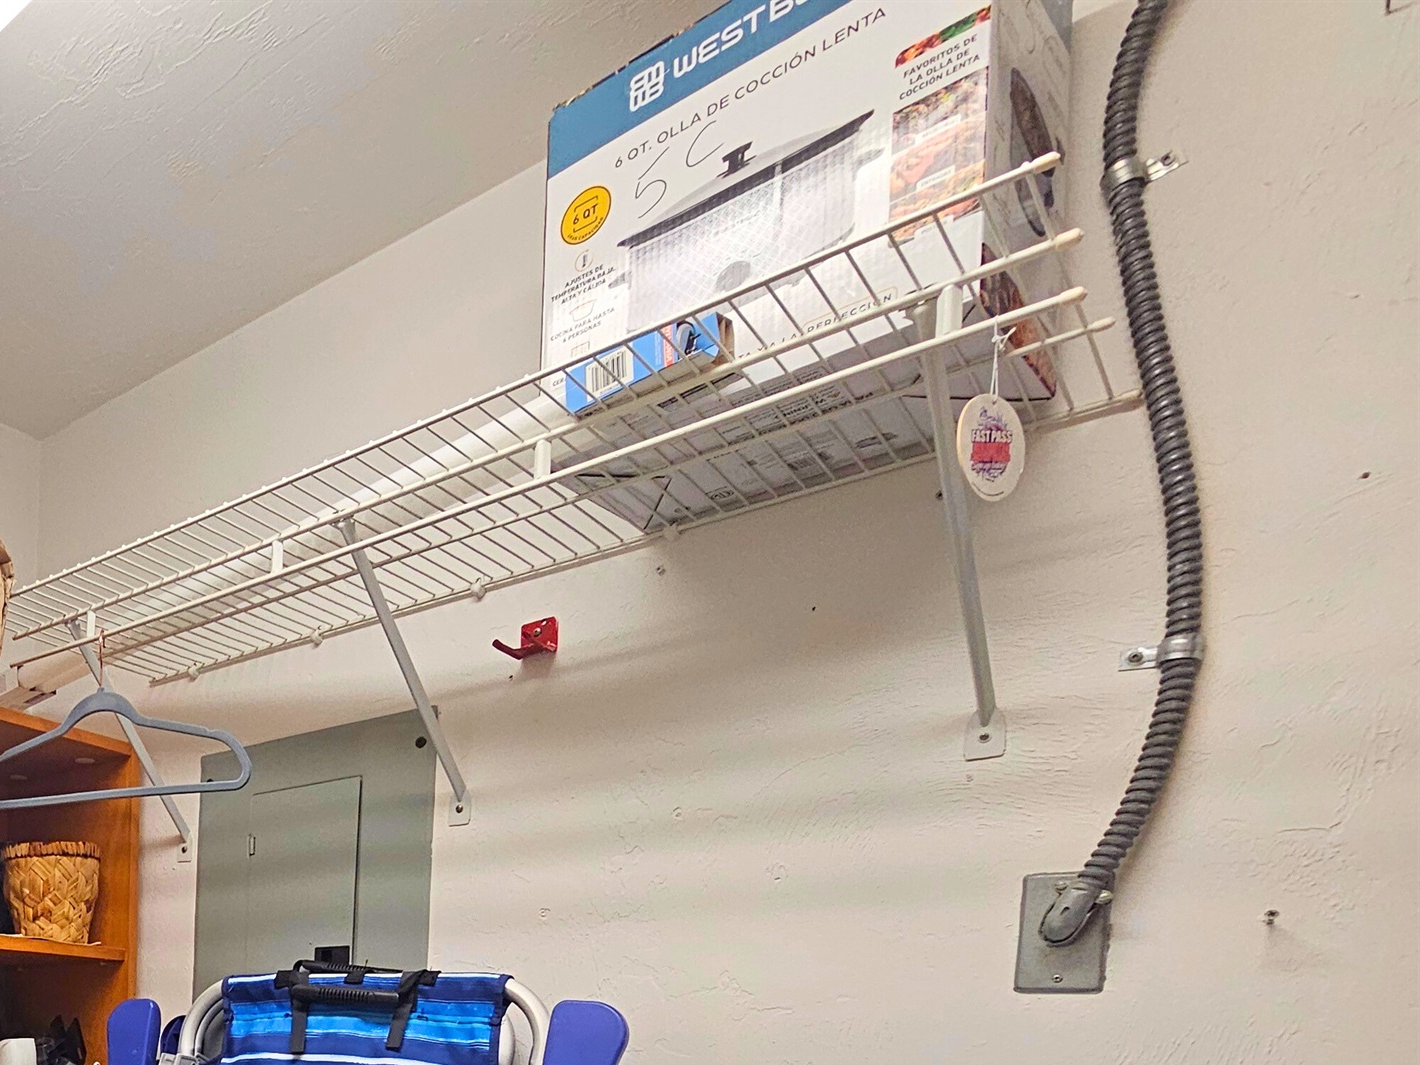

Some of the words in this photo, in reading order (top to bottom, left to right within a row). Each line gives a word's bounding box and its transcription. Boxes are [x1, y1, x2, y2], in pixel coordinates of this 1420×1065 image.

[673, 5, 767, 78] WEST
[902, 43, 961, 80] FAVORITOS
[963, 33, 978, 48] DE
[614, 156, 624, 168] 6
[656, 112, 702, 144] OLLA
[706, 95, 730, 117] DE
[734, 45, 817, 100] COCCIÓN
[821, 7, 886, 52] LENTA
[899, 73, 943, 101] COCCIÓN
[945, 53, 981, 82] LENTA
[909, 73, 925, 86] LA
[926, 57, 954, 78] OLLA
[955, 48, 971, 62] DE
[572, 213, 579, 225] 6
[583, 203, 599, 219] QT
[595, 263, 604, 273] DE
